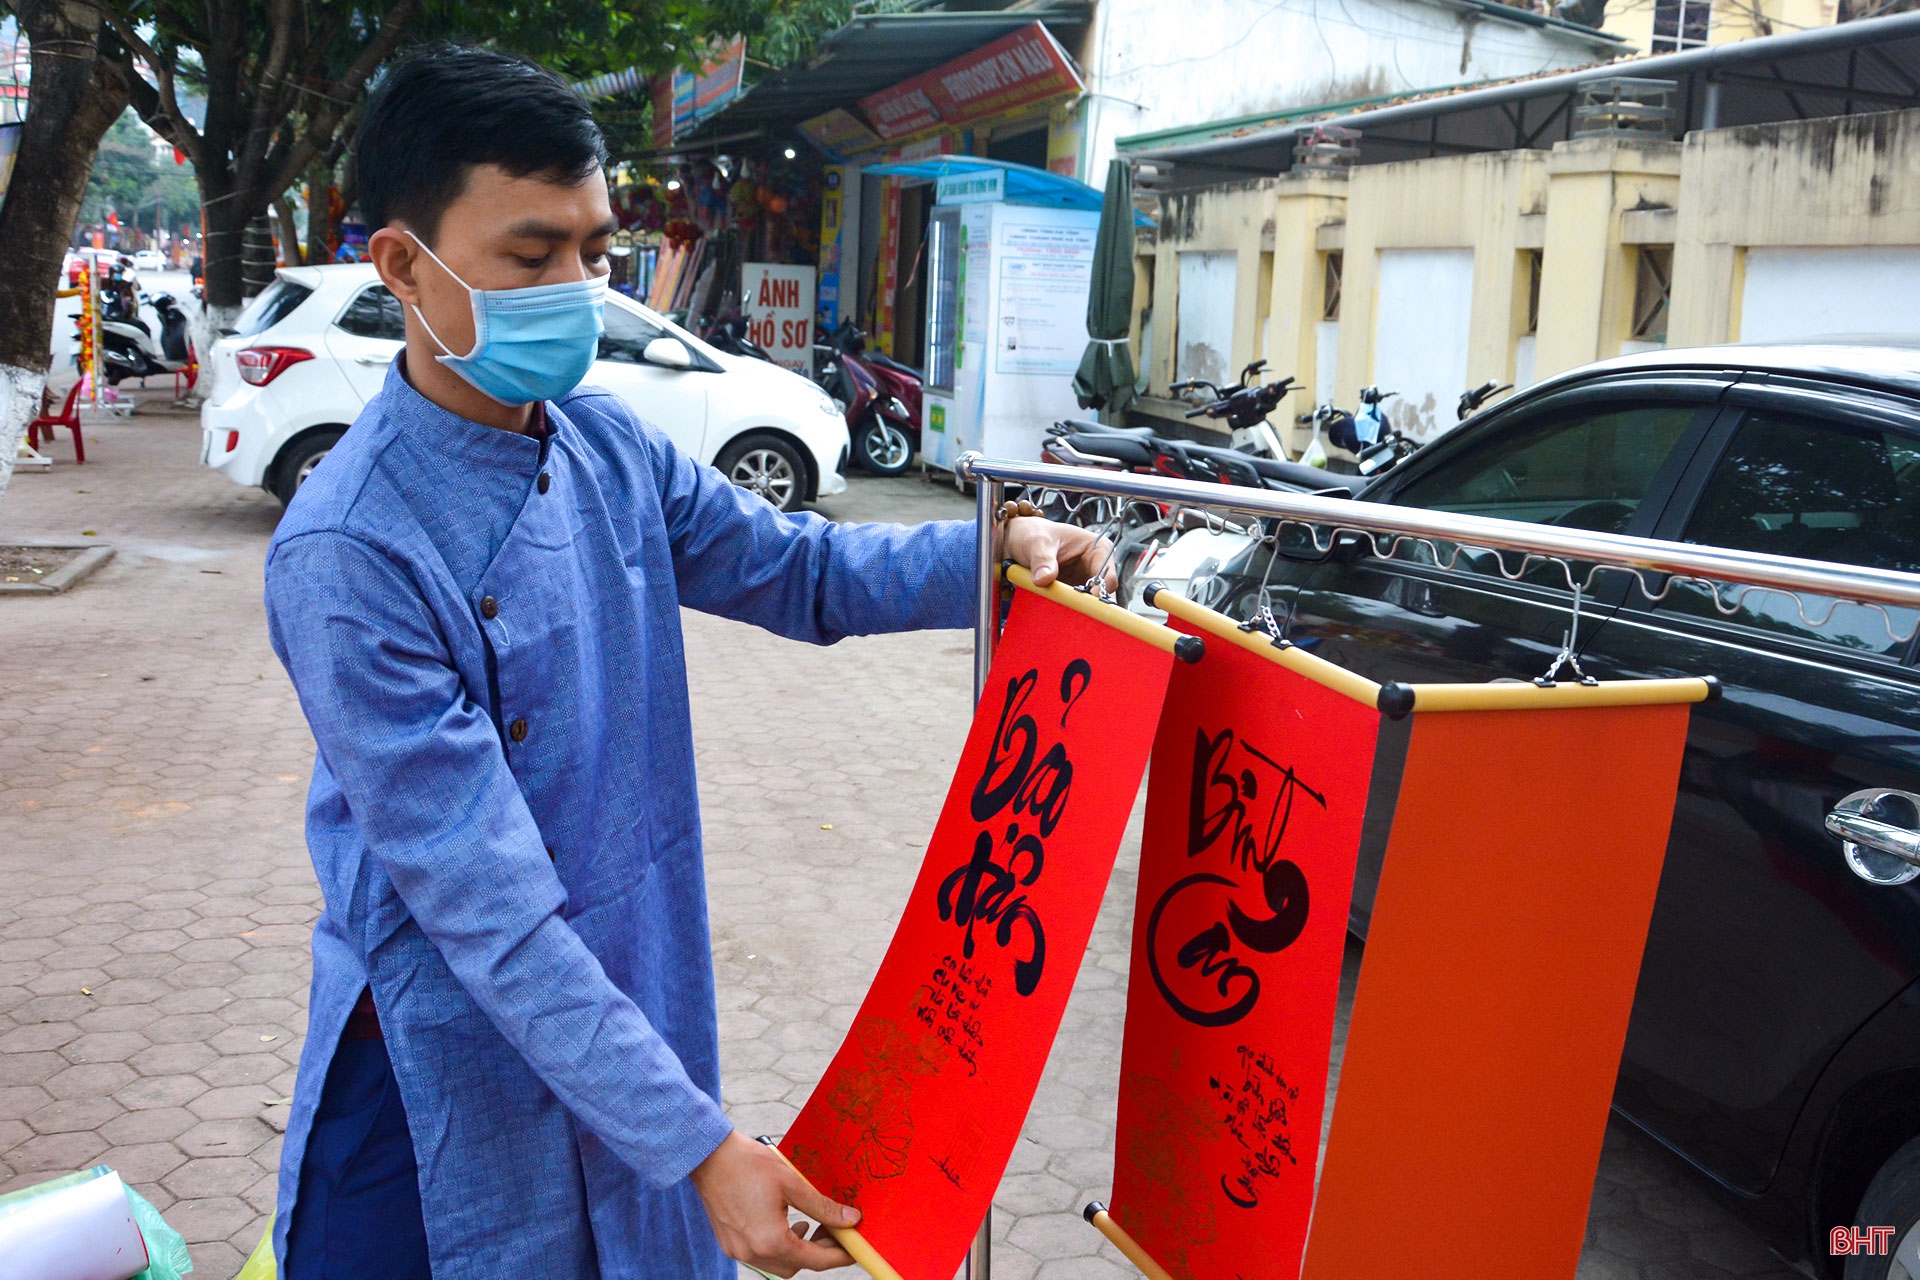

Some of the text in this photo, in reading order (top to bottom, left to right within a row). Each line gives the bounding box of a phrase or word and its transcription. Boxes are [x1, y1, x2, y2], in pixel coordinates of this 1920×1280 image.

[758, 269, 799, 308] ẢNH
[749, 311, 809, 349] HỒ SƠ
